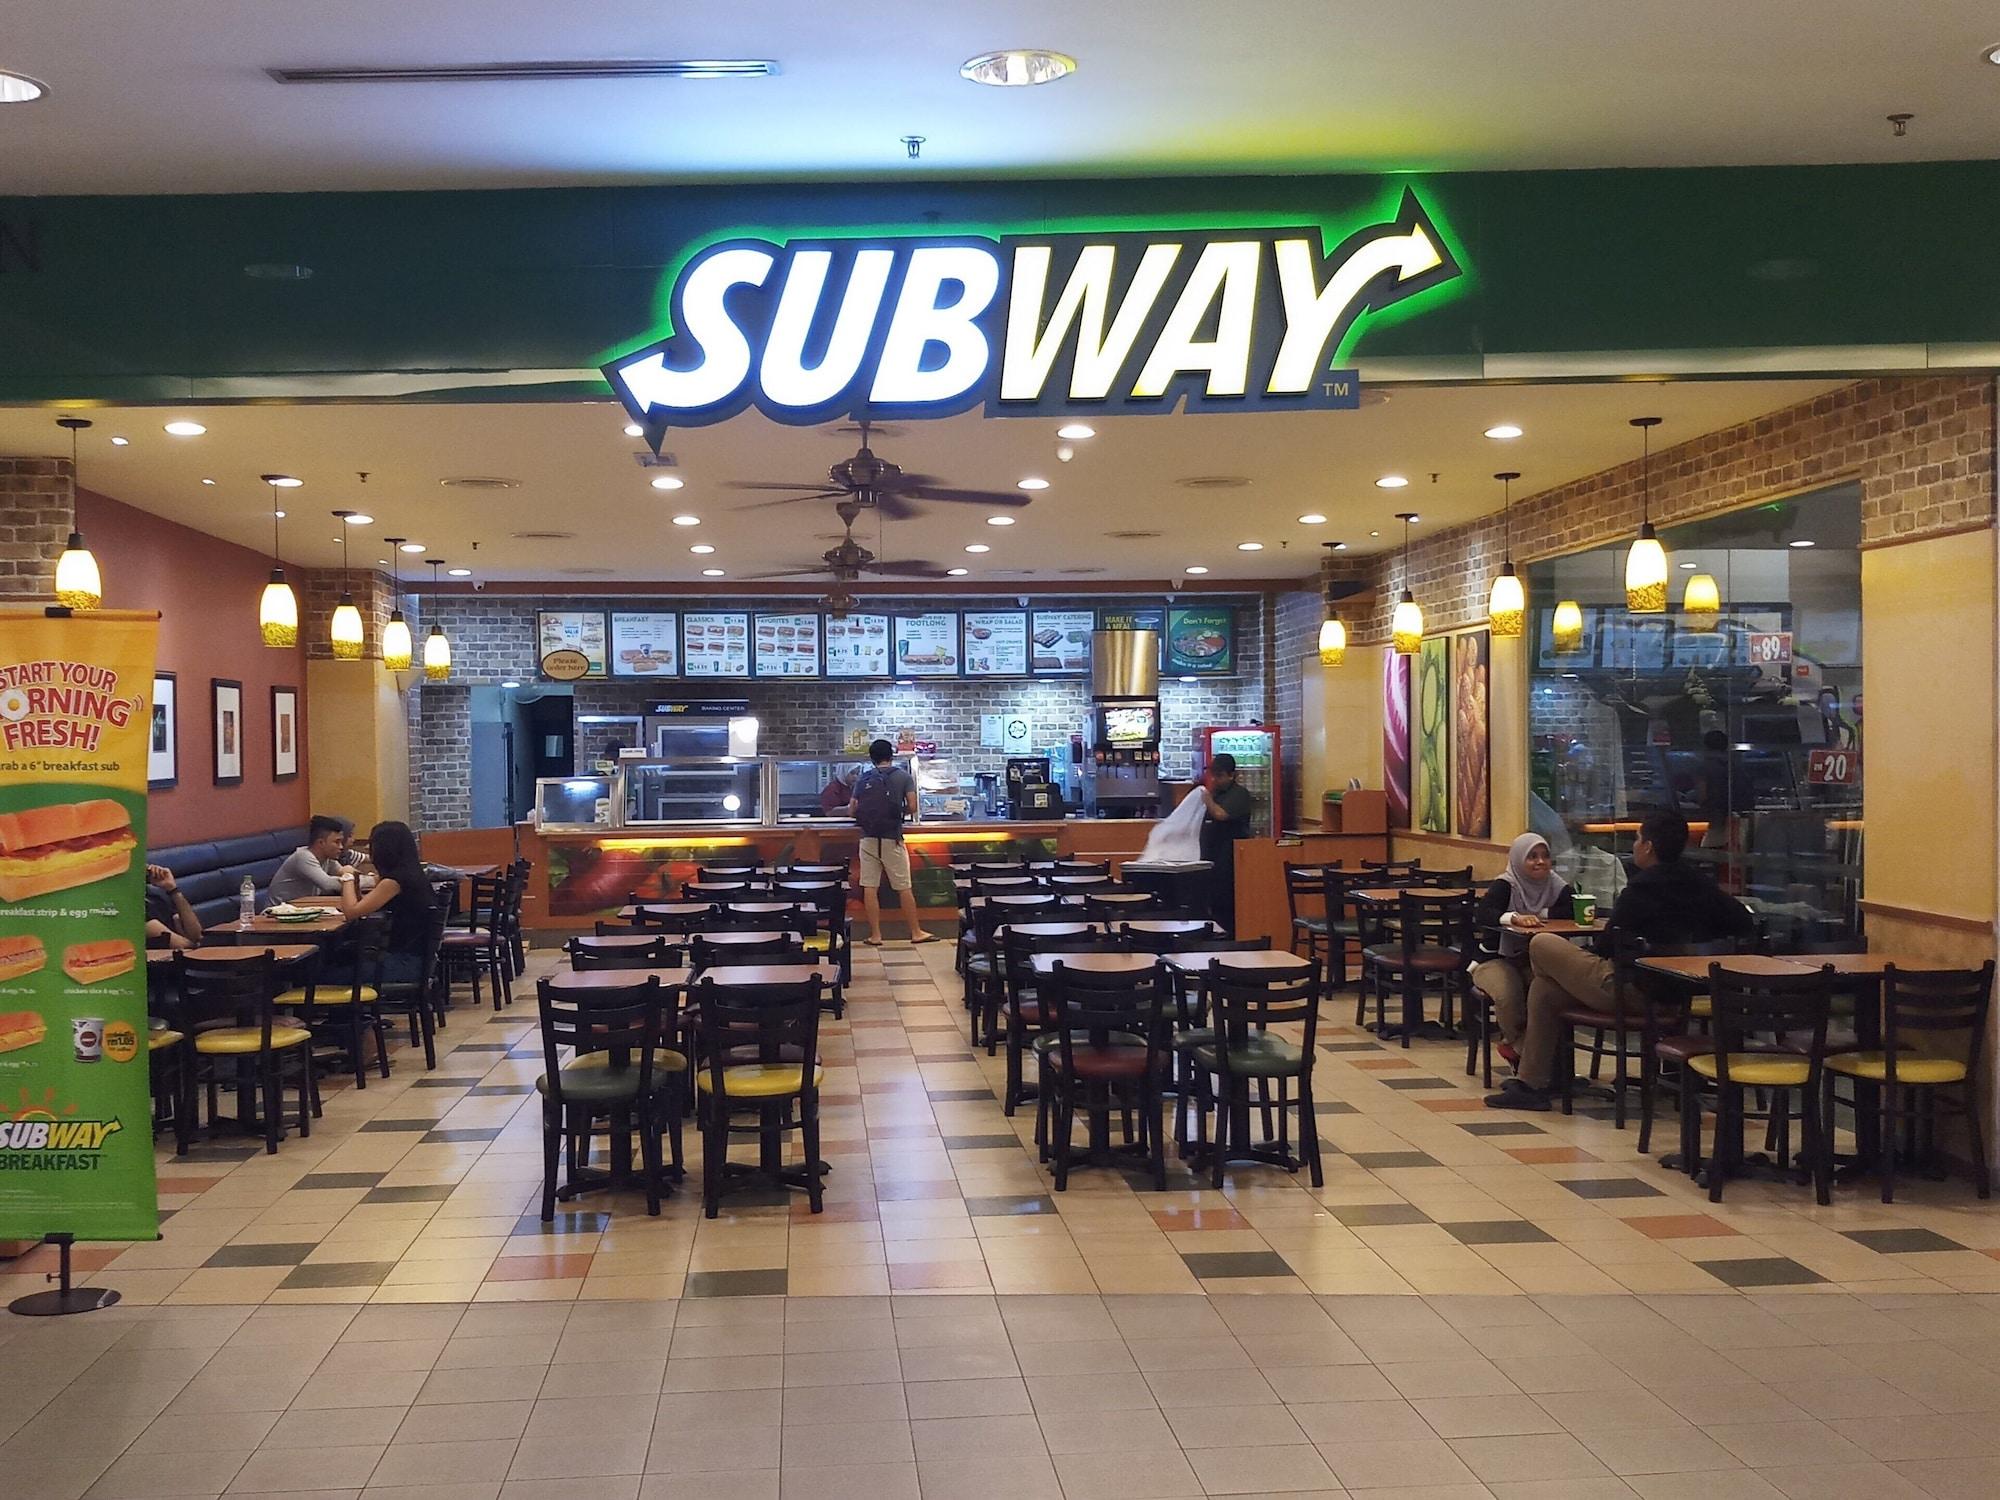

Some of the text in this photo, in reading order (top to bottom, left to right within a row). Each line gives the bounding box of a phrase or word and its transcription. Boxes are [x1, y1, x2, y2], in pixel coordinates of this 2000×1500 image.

[617, 222, 1443, 416] SUBWAY
[1761, 635, 1781, 661] 89
[0, 662, 117, 692] START YOUR
[3, 719, 100, 751] FRESH!
[43, 760, 99, 771] breakfast
[100, 761, 120, 772] sub
[1824, 755, 1847, 781] 20
[69, 908, 88, 919] egg
[0, 1119, 122, 1149] SUBWAY
[0, 1154, 99, 1170] BREAKFAST
